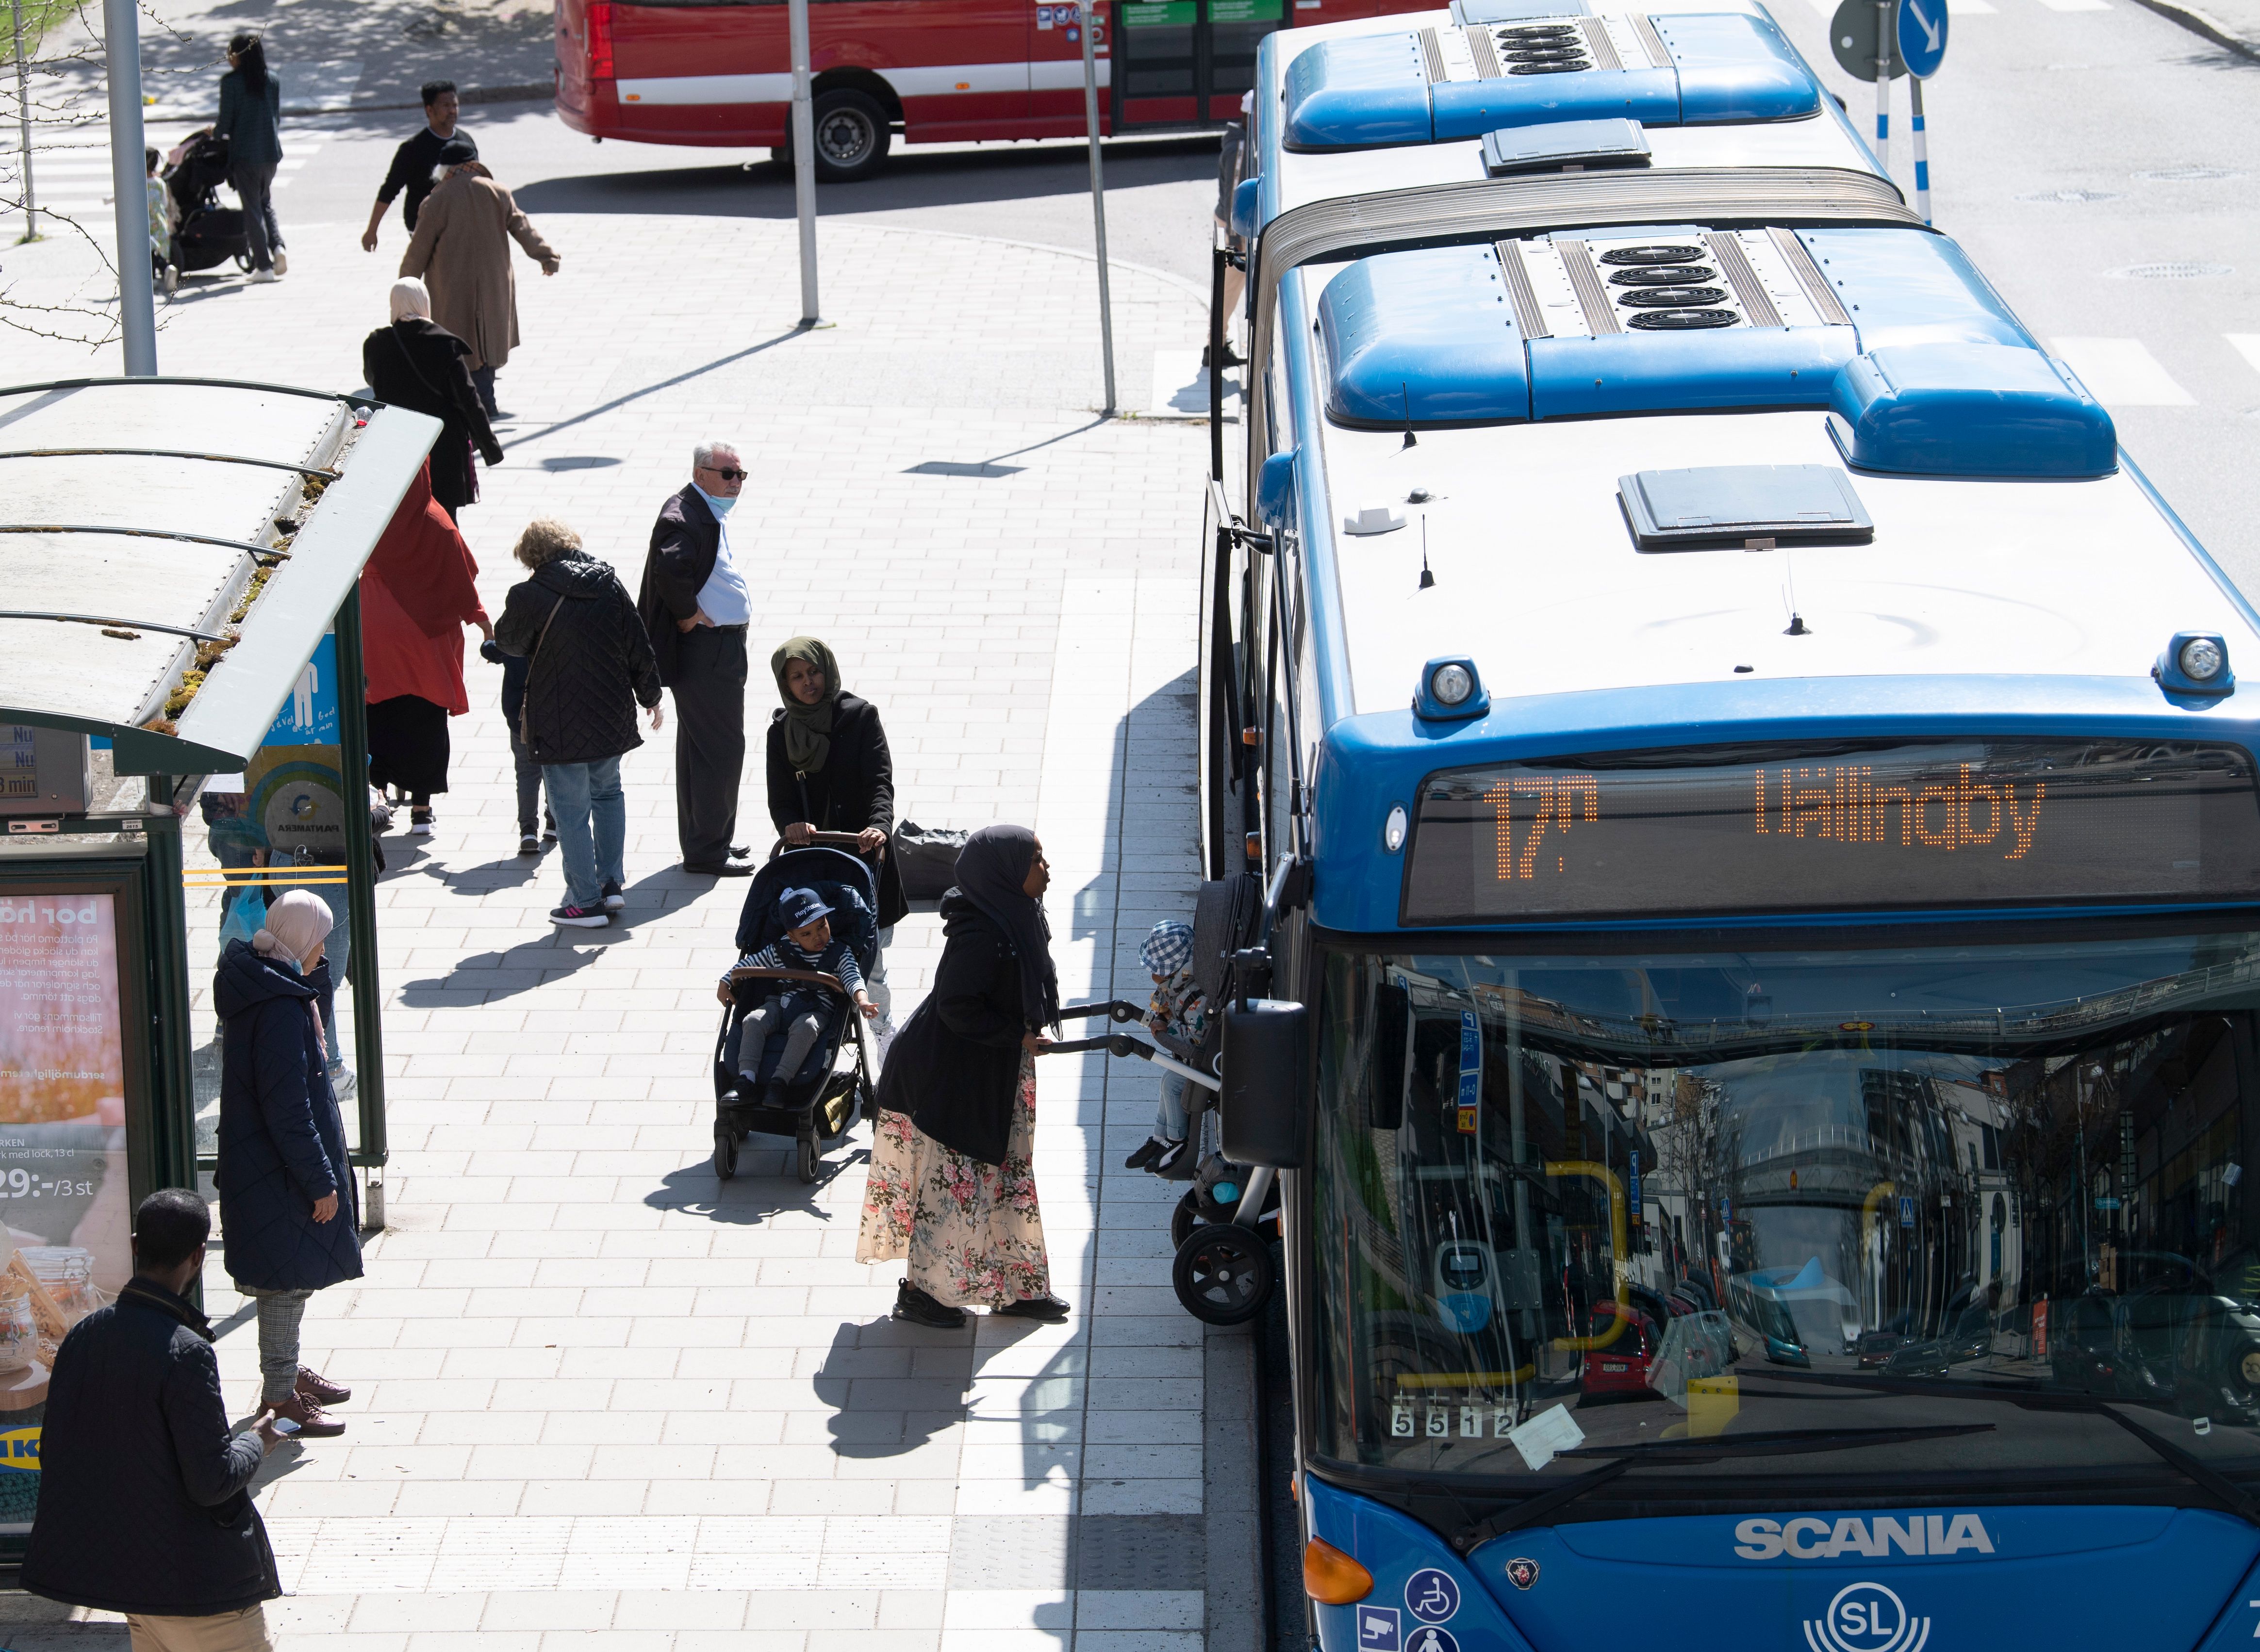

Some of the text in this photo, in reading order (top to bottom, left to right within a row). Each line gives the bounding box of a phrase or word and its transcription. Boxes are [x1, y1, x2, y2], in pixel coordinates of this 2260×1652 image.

[14, 727, 33, 743] Nu
[16, 752, 34, 768] Nu
[9, 776, 35, 792] min
[794, 903, 821, 918] PlayStation
[9, 1150, 29, 1159] med
[32, 1149, 53, 1158] lock,
[67, 1148, 74, 1157] cl
[76, 1181, 93, 1195] st
[1734, 1514, 1995, 1560] SCANIA
[1840, 1601, 1892, 1636] SL
